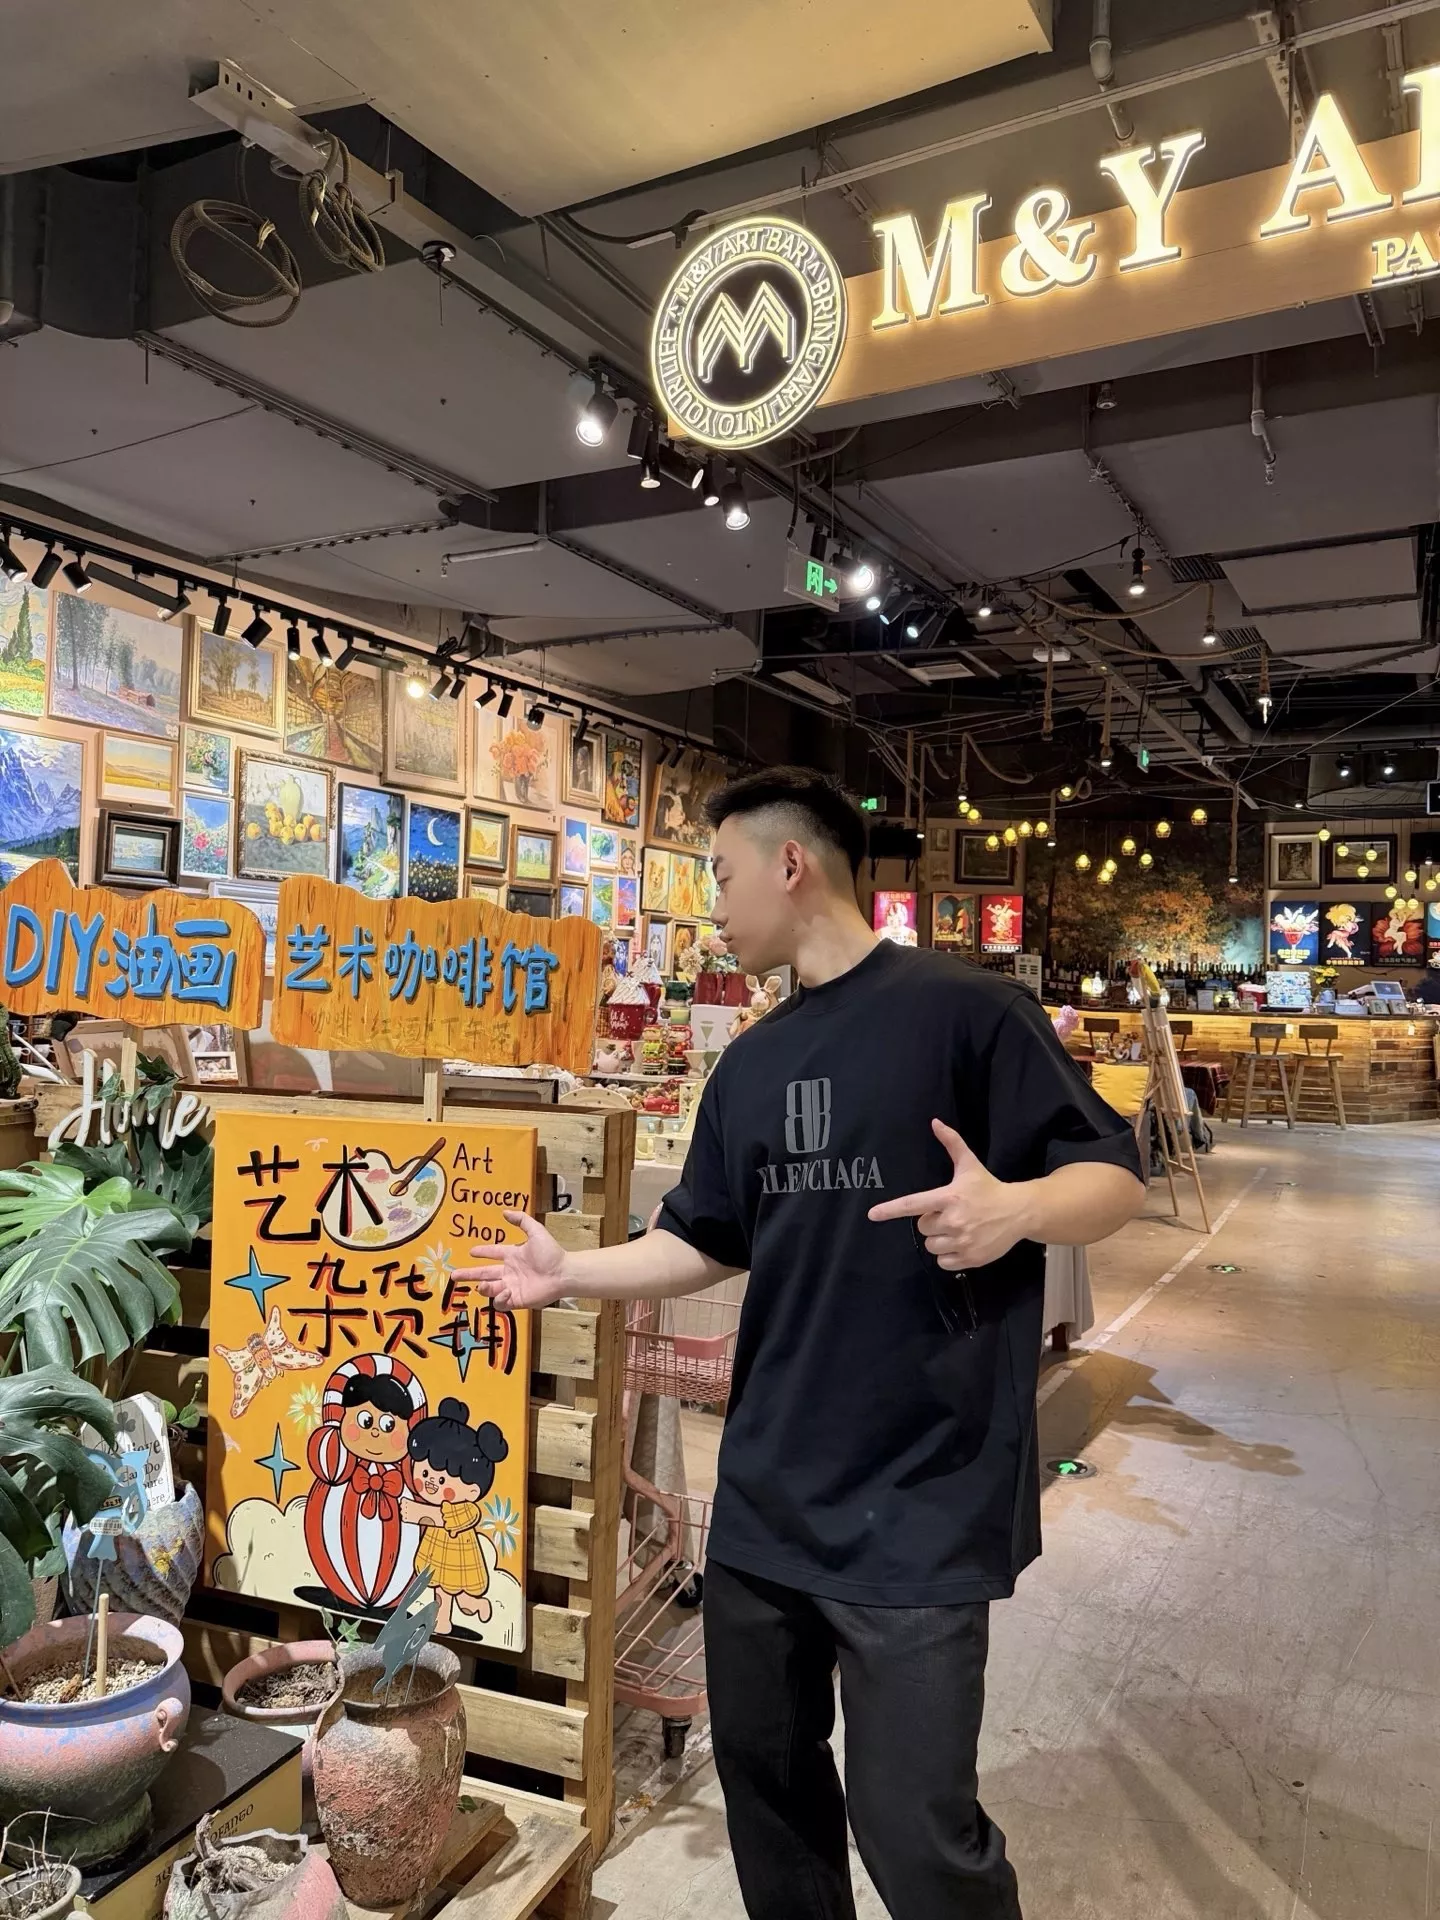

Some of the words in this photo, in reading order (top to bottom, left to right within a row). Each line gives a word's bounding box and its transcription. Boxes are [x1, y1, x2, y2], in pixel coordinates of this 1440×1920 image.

[871, 131, 1206, 332] M&Y
[1371, 231, 1440, 287] PA
[674, 249, 716, 300] M&Y
[718, 227, 768, 260] ART
[765, 227, 812, 268] BAR
[805, 276, 835, 367] BRING
[666, 374, 715, 433] YOUR
[777, 364, 816, 417] ART
[718, 409, 771, 438] INTO
[285, 922, 560, 1015] 艺术咖啡馆
[452, 1142, 494, 1174] Art
[236, 1144, 383, 1245] 艺术
[450, 1177, 530, 1213] Grocery
[448, 1213, 506, 1245] Shop
